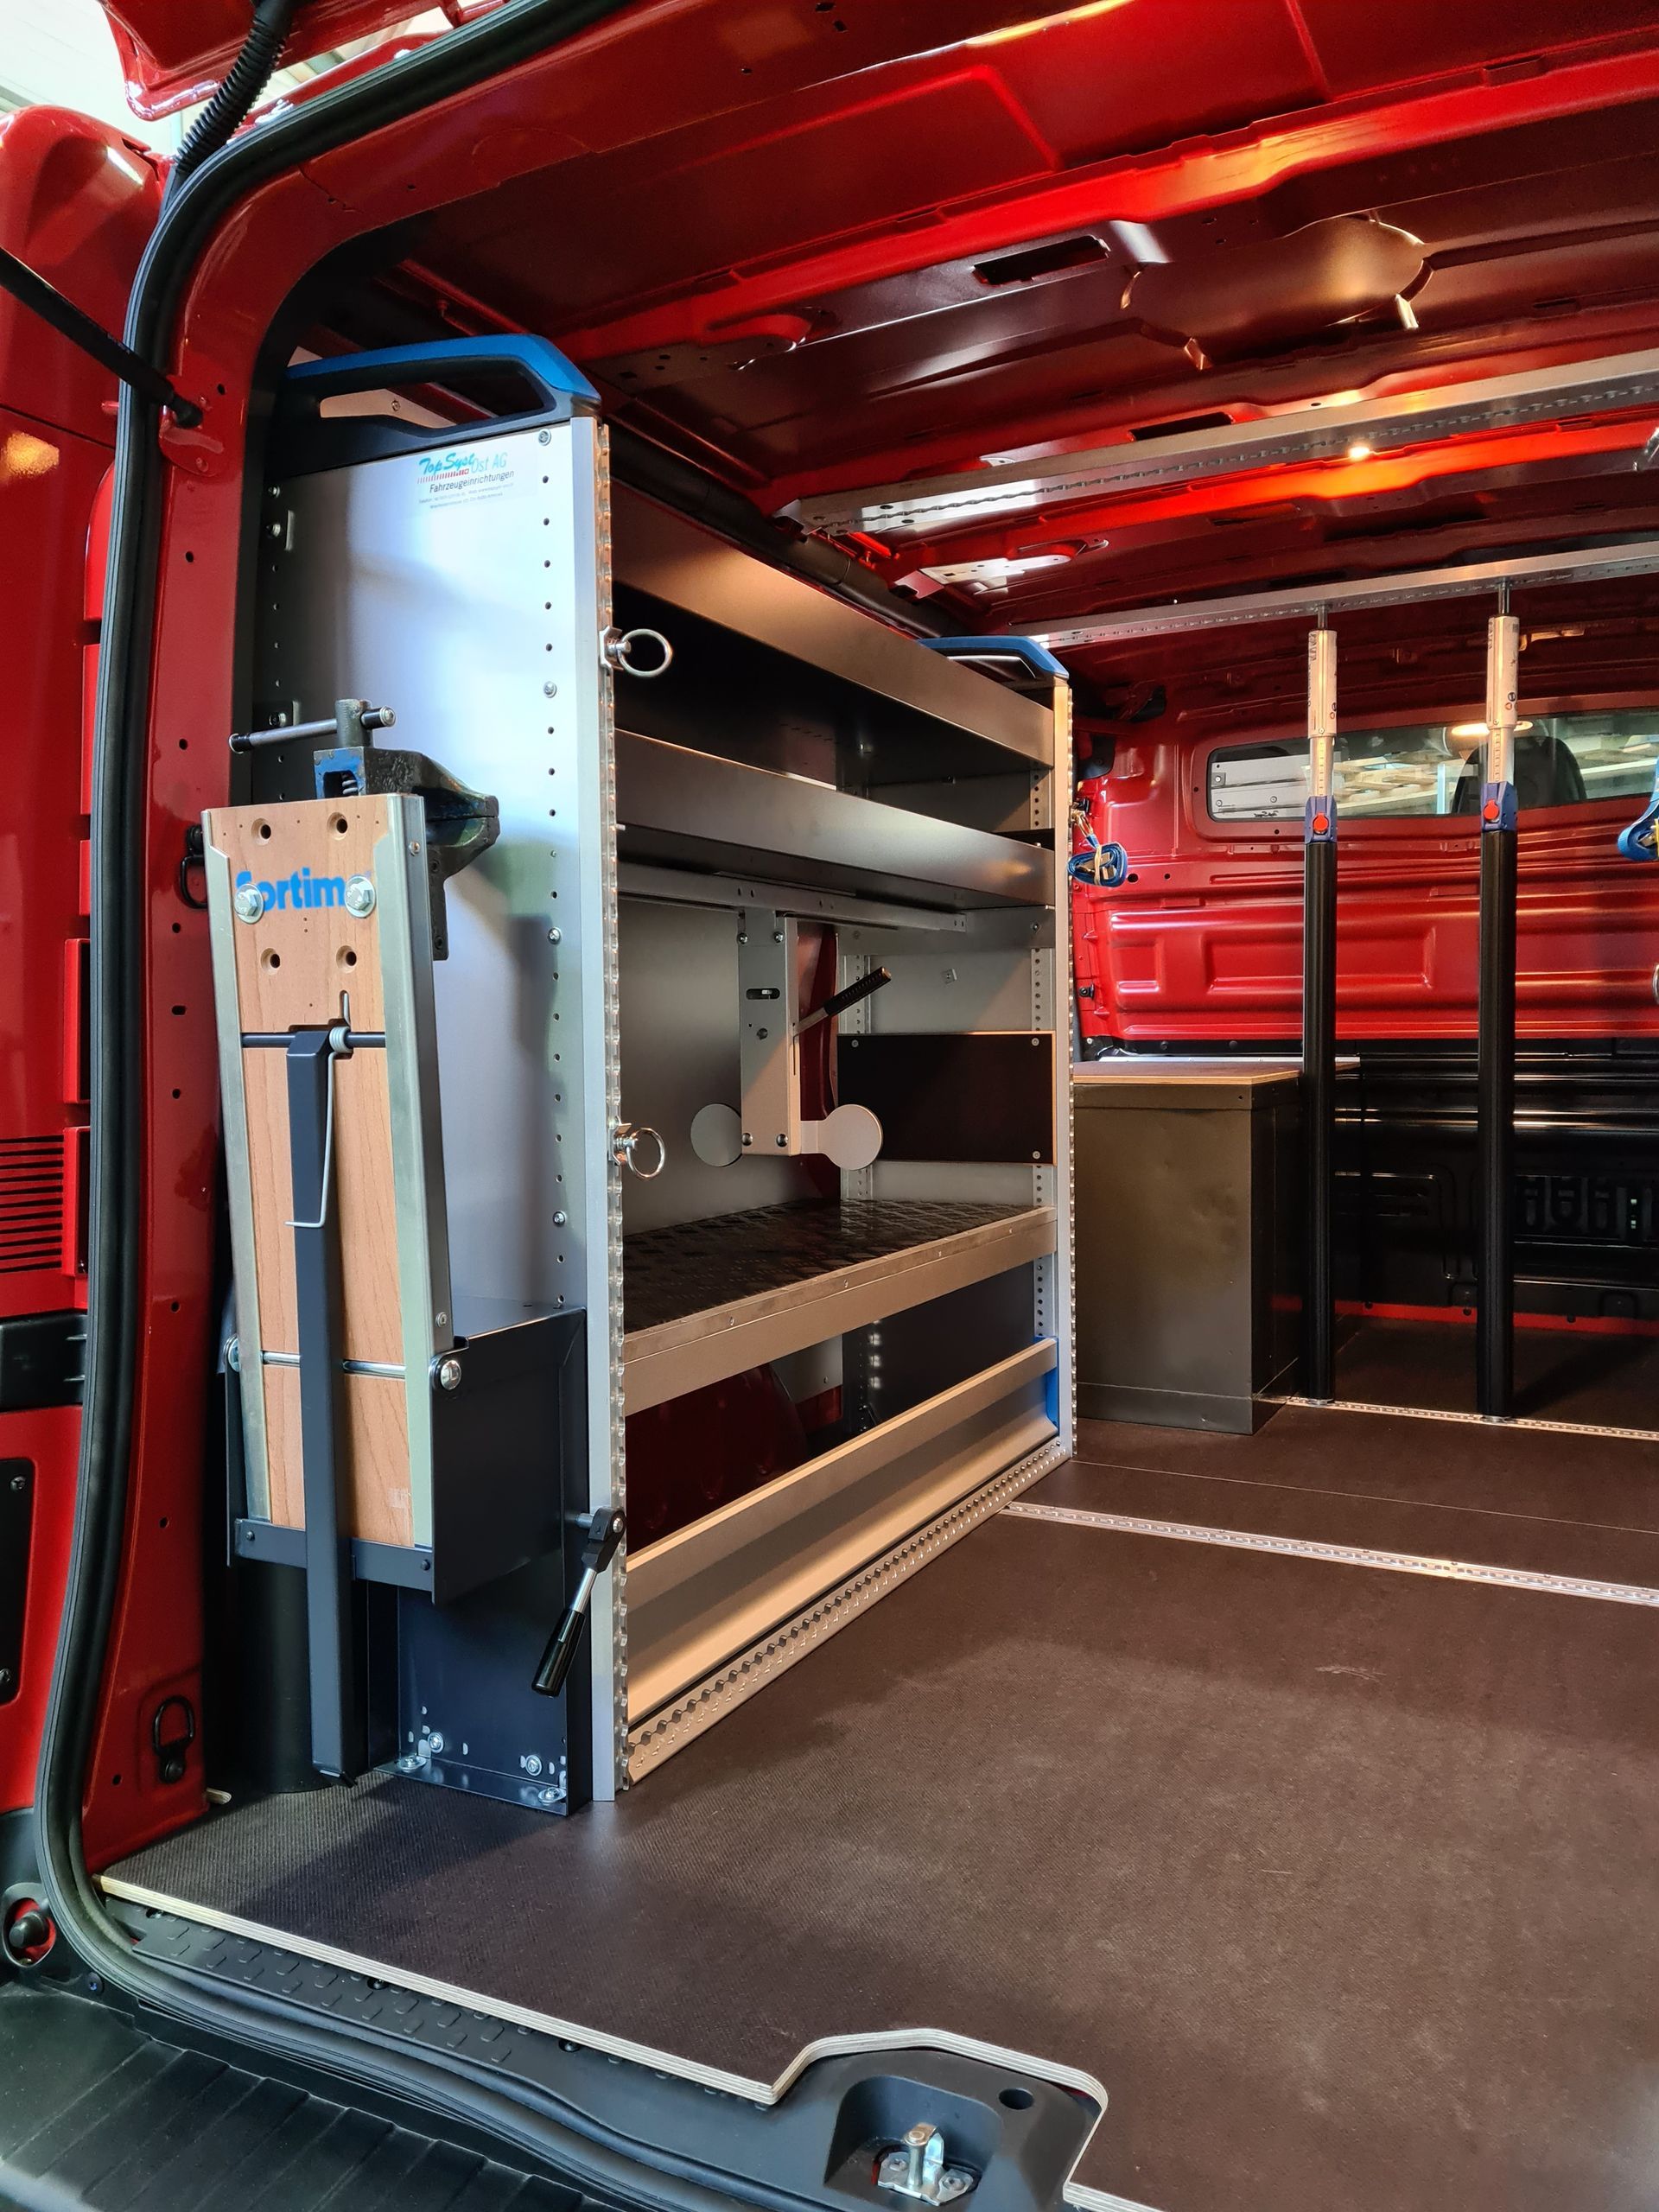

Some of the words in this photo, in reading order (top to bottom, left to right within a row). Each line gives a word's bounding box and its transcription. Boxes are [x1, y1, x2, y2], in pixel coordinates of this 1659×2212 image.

[492, 452, 508, 470] AG
[429, 470, 515, 493] Fahrzeugeinrichtungen
[236, 867, 347, 912] ortim
